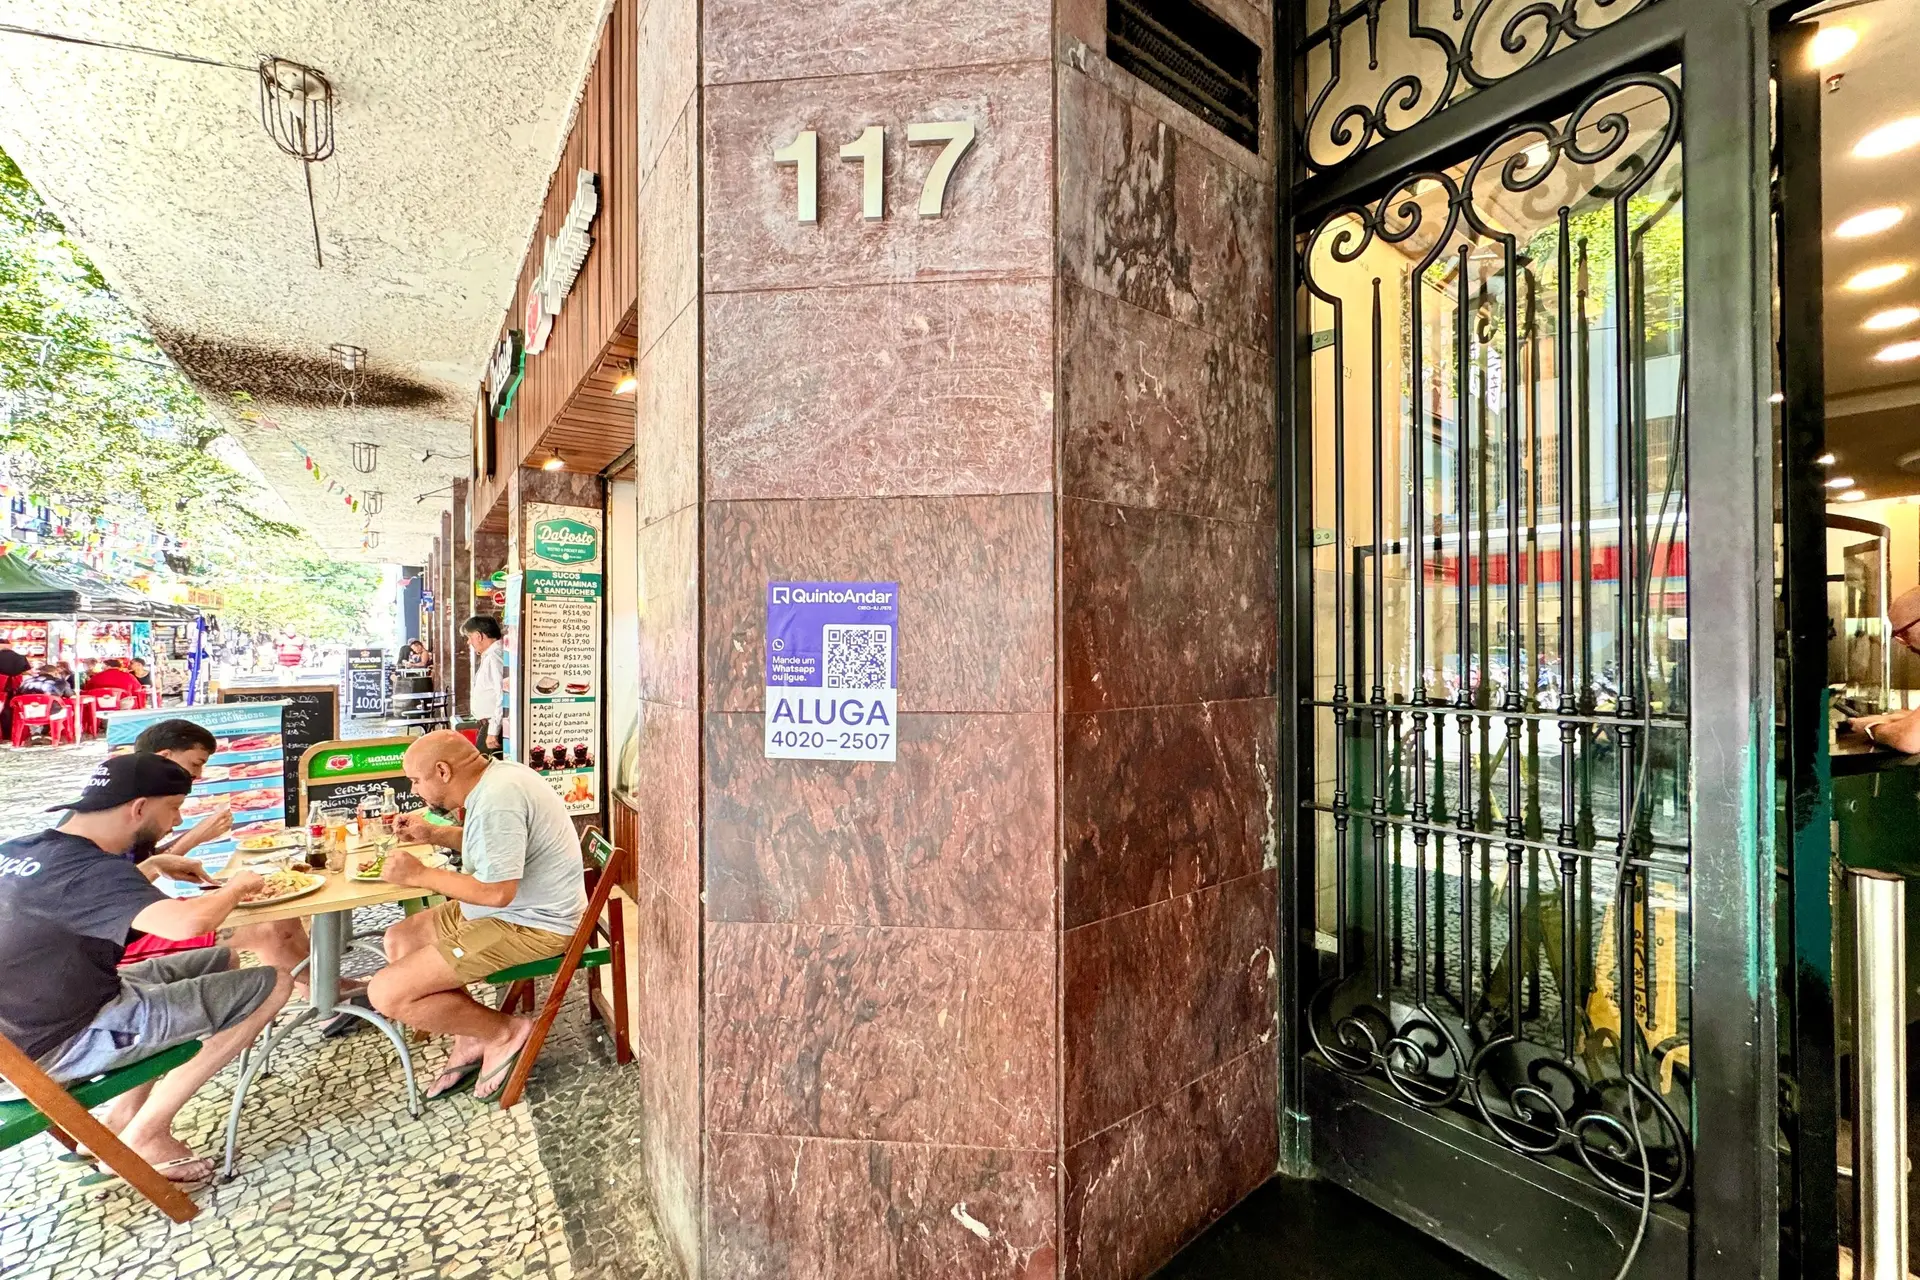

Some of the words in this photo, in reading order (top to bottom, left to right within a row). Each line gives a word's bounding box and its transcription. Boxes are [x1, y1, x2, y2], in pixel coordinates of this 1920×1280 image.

[774, 117, 976, 224] 117
[537, 525, 595, 546] DaGosto
[552, 571, 580, 580] SUCOS
[792, 588, 893, 604] QuintoAndar
[772, 655, 800, 665] Mande
[802, 657, 815, 665] um
[772, 664, 816, 675] Whatsapp
[783, 672, 807, 683] ligue.
[772, 698, 890, 726] ALUGA
